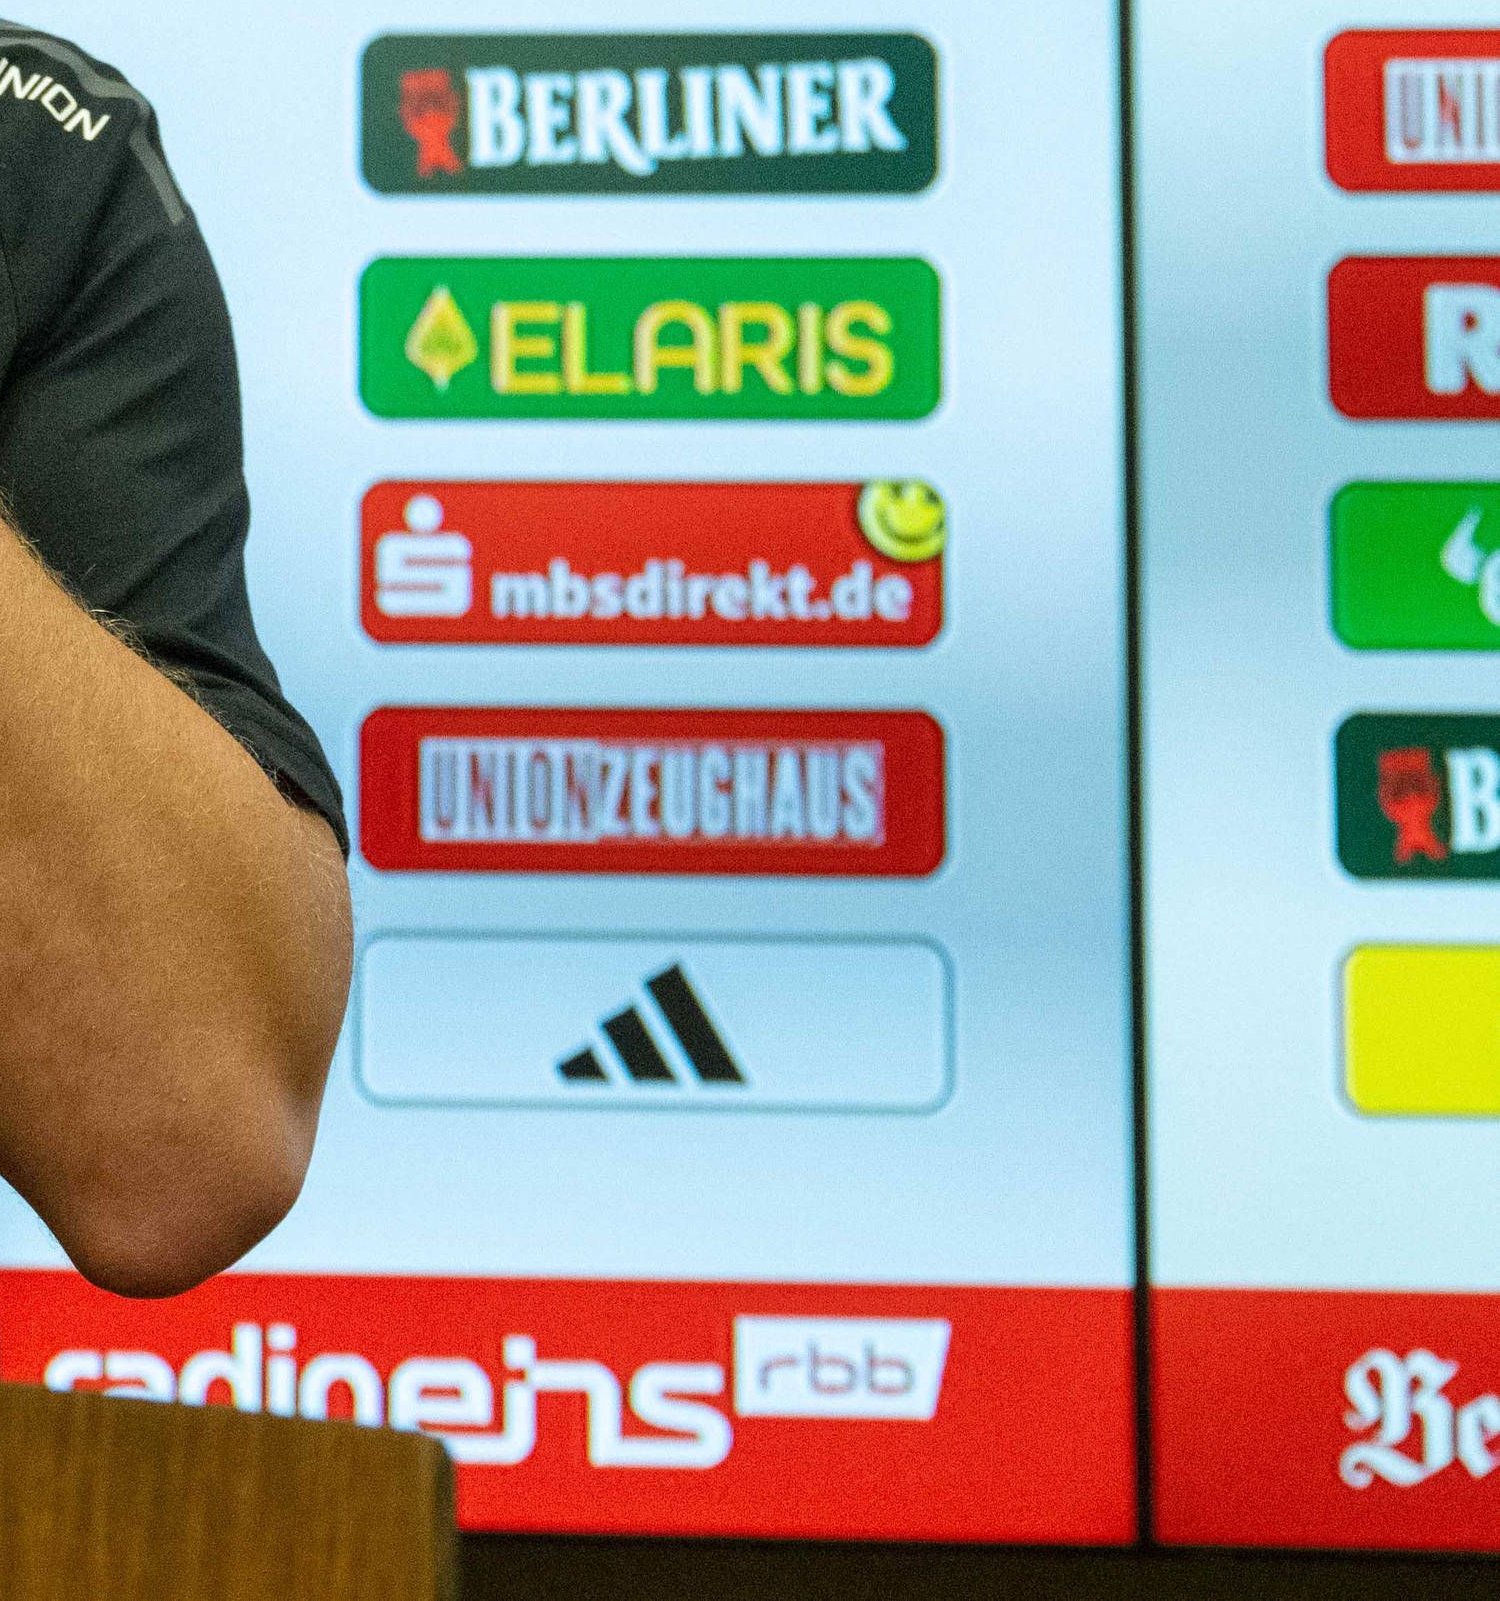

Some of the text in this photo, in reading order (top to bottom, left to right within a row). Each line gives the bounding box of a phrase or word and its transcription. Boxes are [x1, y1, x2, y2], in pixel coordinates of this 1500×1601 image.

[466, 57, 907, 176] BERLINER
[491, 299, 893, 396] ELARIS
[490, 557, 913, 622] mbsdirekt.de
[757, 1335, 916, 1397] rbb
